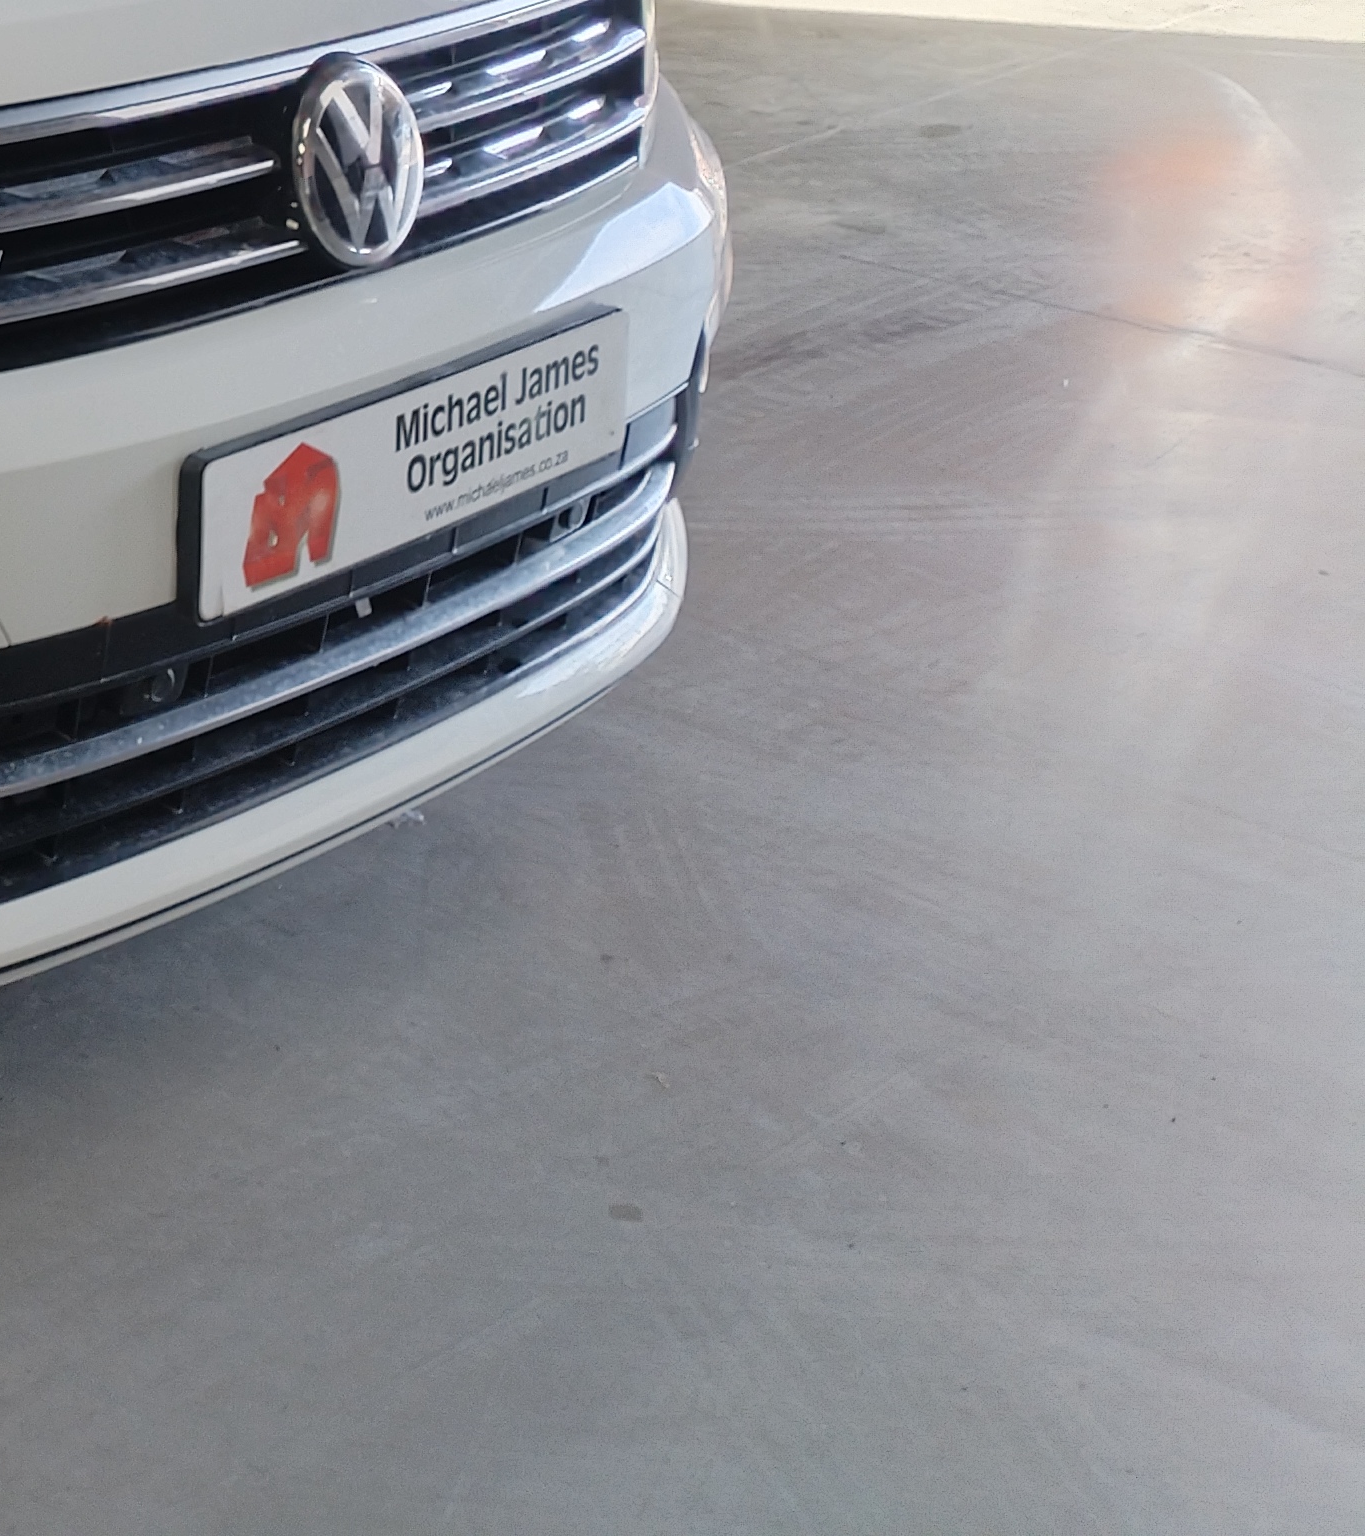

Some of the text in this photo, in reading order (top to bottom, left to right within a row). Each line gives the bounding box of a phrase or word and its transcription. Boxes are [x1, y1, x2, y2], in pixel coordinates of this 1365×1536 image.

[394, 343, 600, 453] Michael James
[407, 393, 587, 495] Organisation
